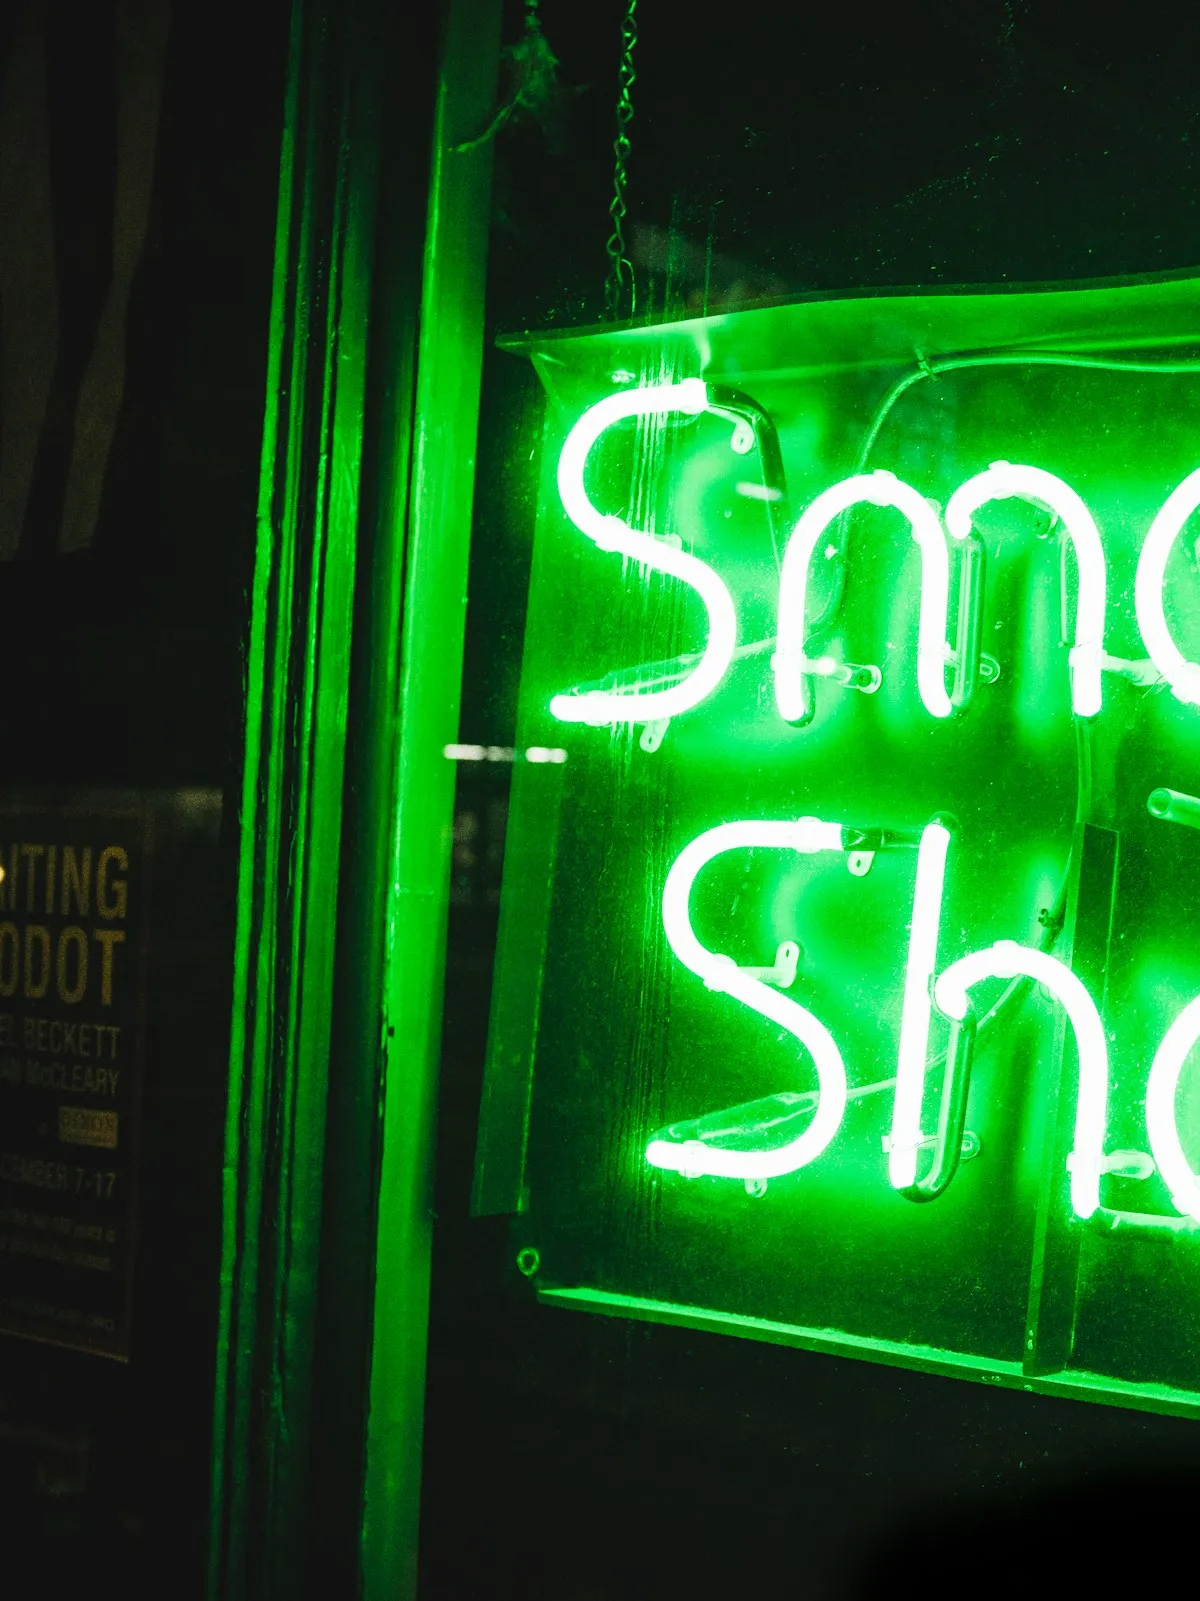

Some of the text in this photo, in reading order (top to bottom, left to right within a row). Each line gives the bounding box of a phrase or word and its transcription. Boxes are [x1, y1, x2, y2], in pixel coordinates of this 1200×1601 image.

[0, 842, 129, 919] ITING
[24, 1017, 121, 1060] BECKETT
[75, 1168, 116, 1198] 7-17
